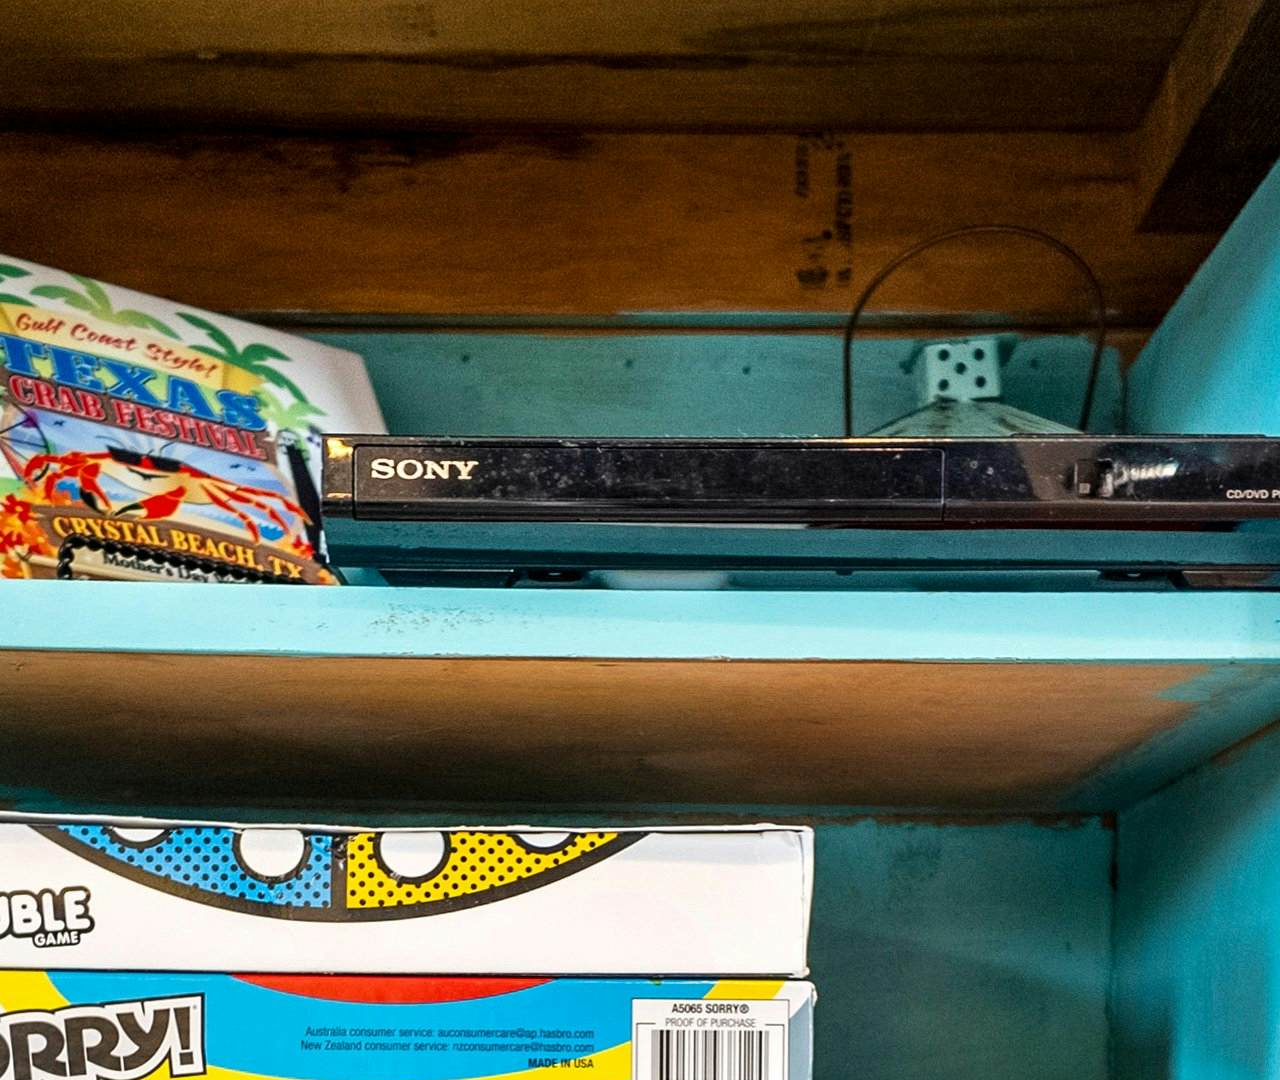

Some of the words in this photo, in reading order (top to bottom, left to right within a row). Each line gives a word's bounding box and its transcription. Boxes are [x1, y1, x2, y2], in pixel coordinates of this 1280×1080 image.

[70, 323, 137, 352] Coast
[142, 343, 219, 379] Style!
[7, 373, 108, 423] CRAB
[109, 396, 270, 462] FESTIVAL
[371, 458, 480, 480] SONY
[1225, 489, 1269, 499] CD/DVD
[52, 516, 169, 547] CRYSTAL
[267, 554, 306, 579] TX
[33, 931, 80, 947] GAME
[672, 1003, 703, 1014] A5065
[665, 1018, 695, 1027] PROOF
[696, 1018, 708, 1027] OF
[710, 1018, 757, 1028] PURCHASE
[305, 1026, 347, 1037] Australia
[349, 1027, 395, 1037] consumer
[301, 1040, 322, 1051] New
[324, 1040, 362, 1051] Zealand
[364, 1041, 410, 1052] consumer
[528, 1058, 558, 1069] MADE
[560, 1058, 571, 1069] IN
[574, 1058, 594, 1069] USA
